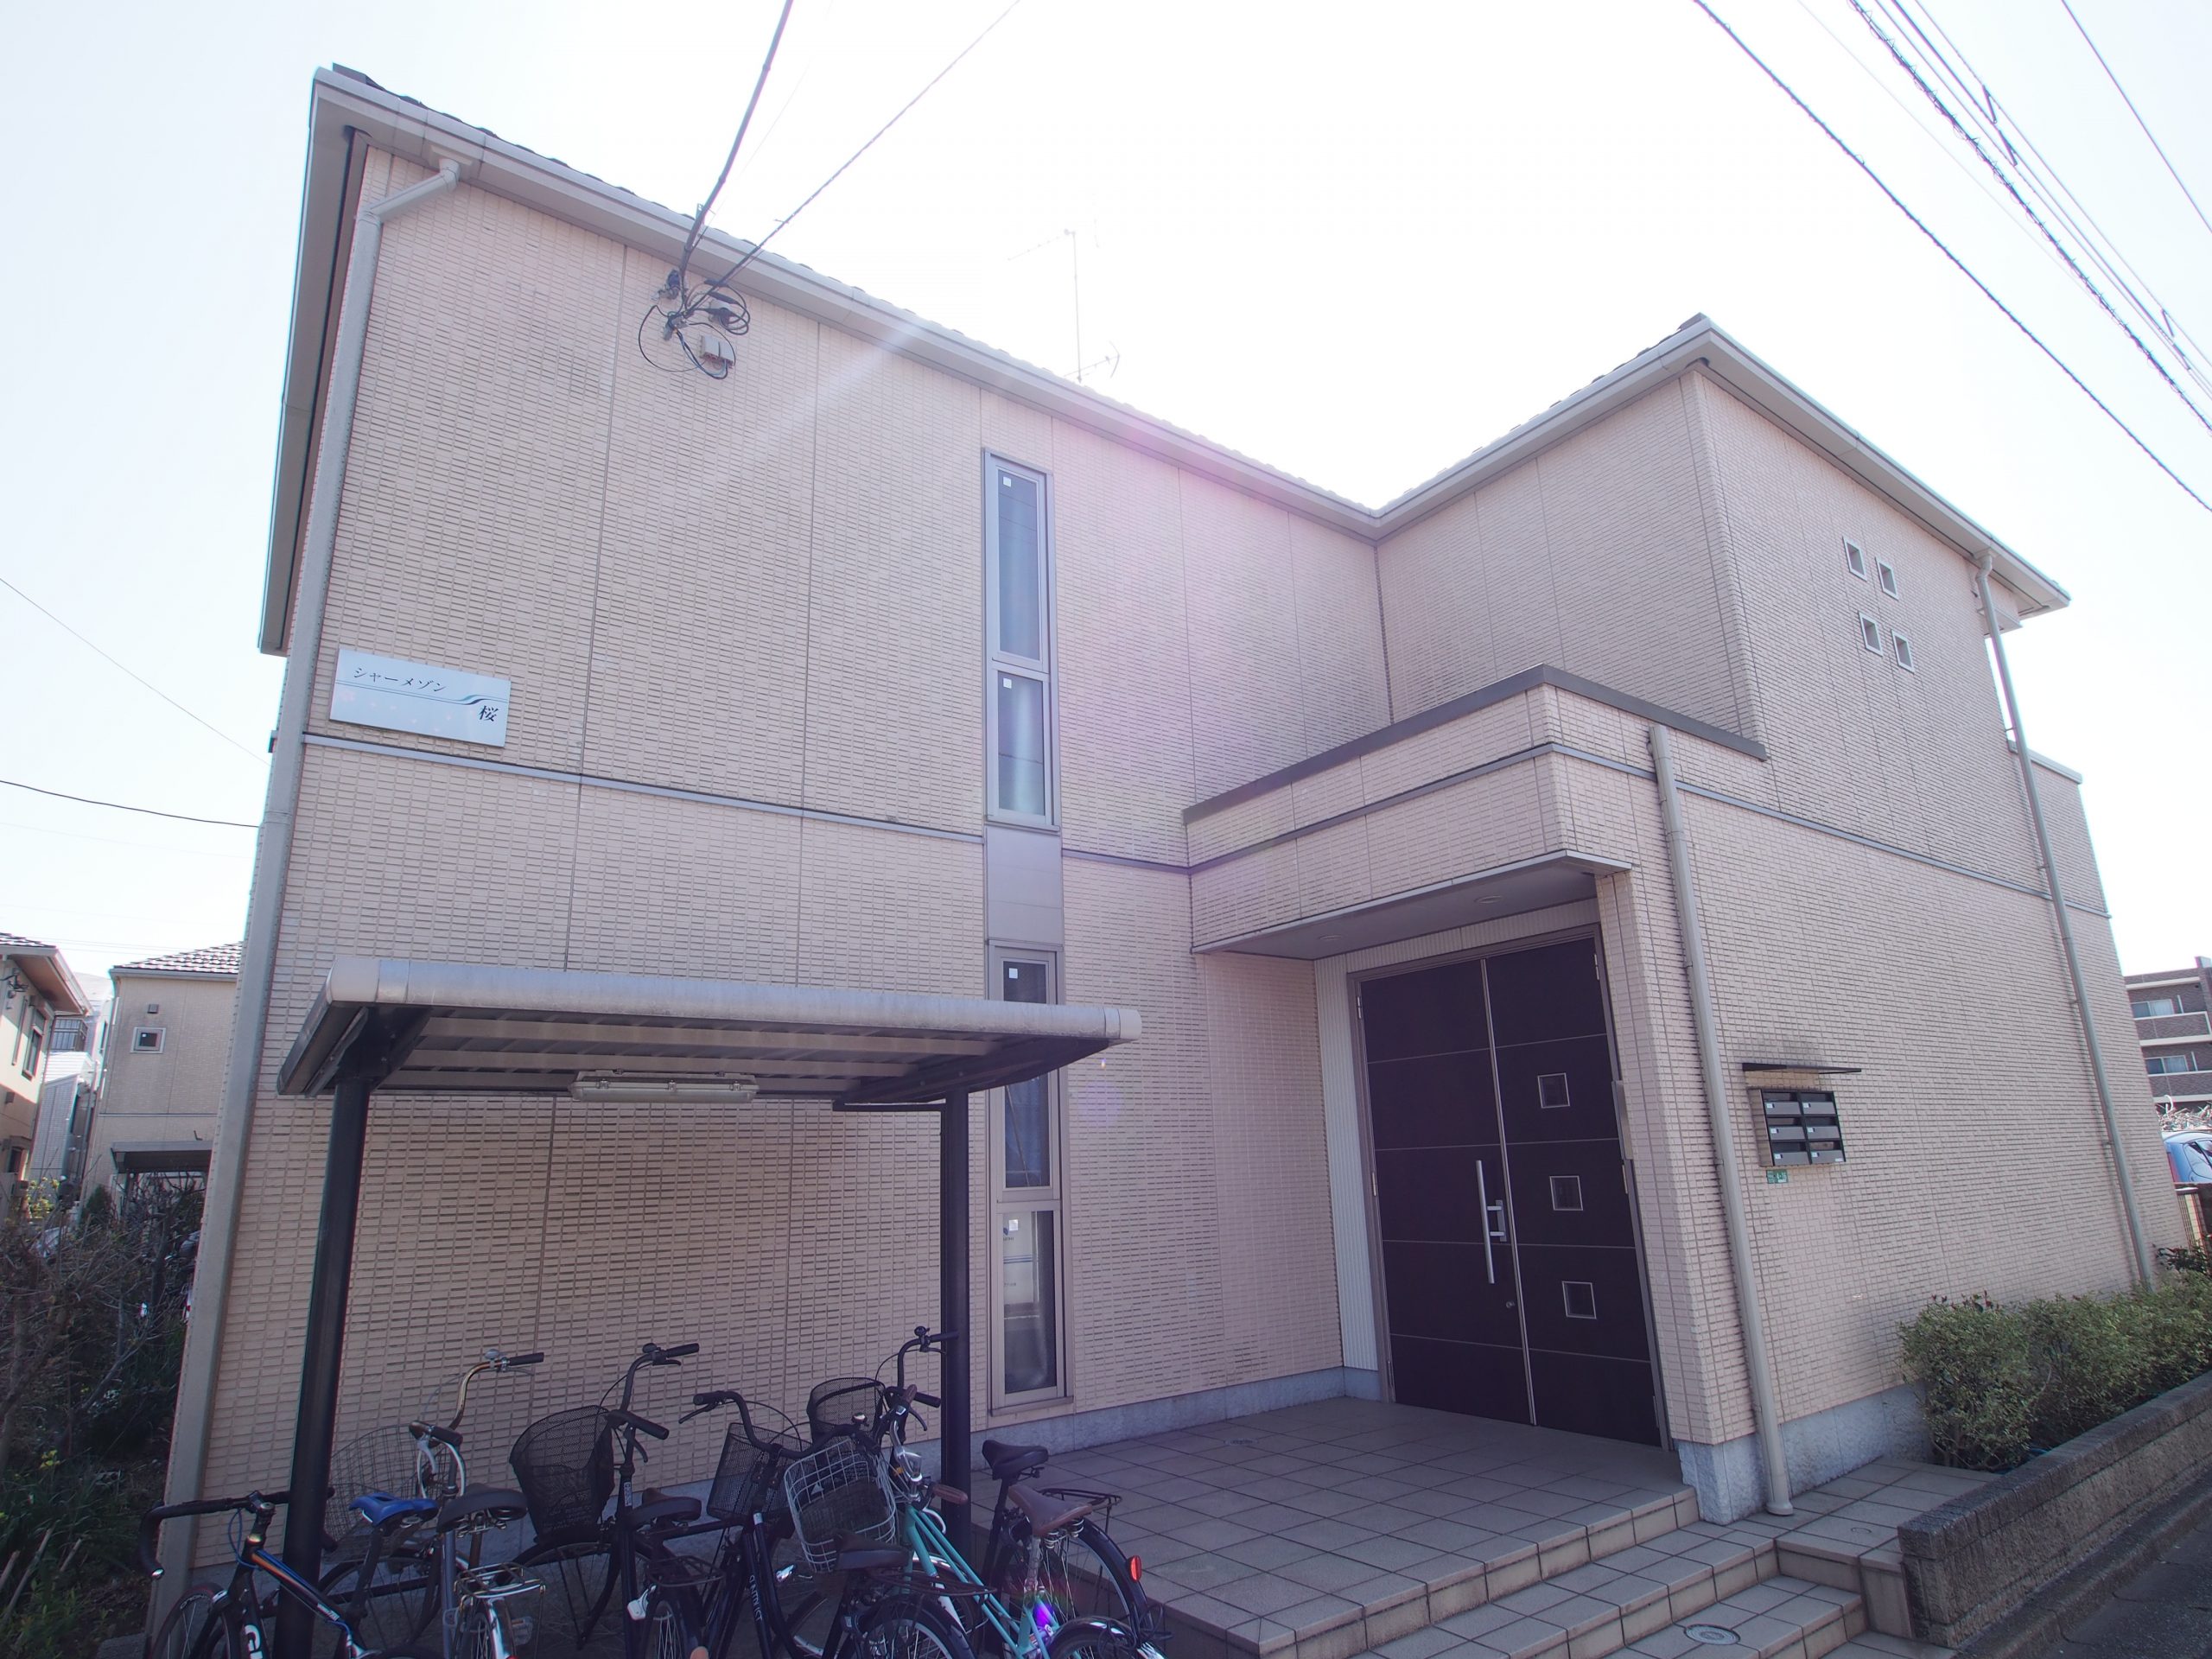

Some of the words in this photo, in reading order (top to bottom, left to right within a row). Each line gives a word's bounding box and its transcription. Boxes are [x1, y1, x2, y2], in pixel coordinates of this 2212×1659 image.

[353, 667, 447, 692] シャーメゾン
[479, 705, 499, 722] 桜
